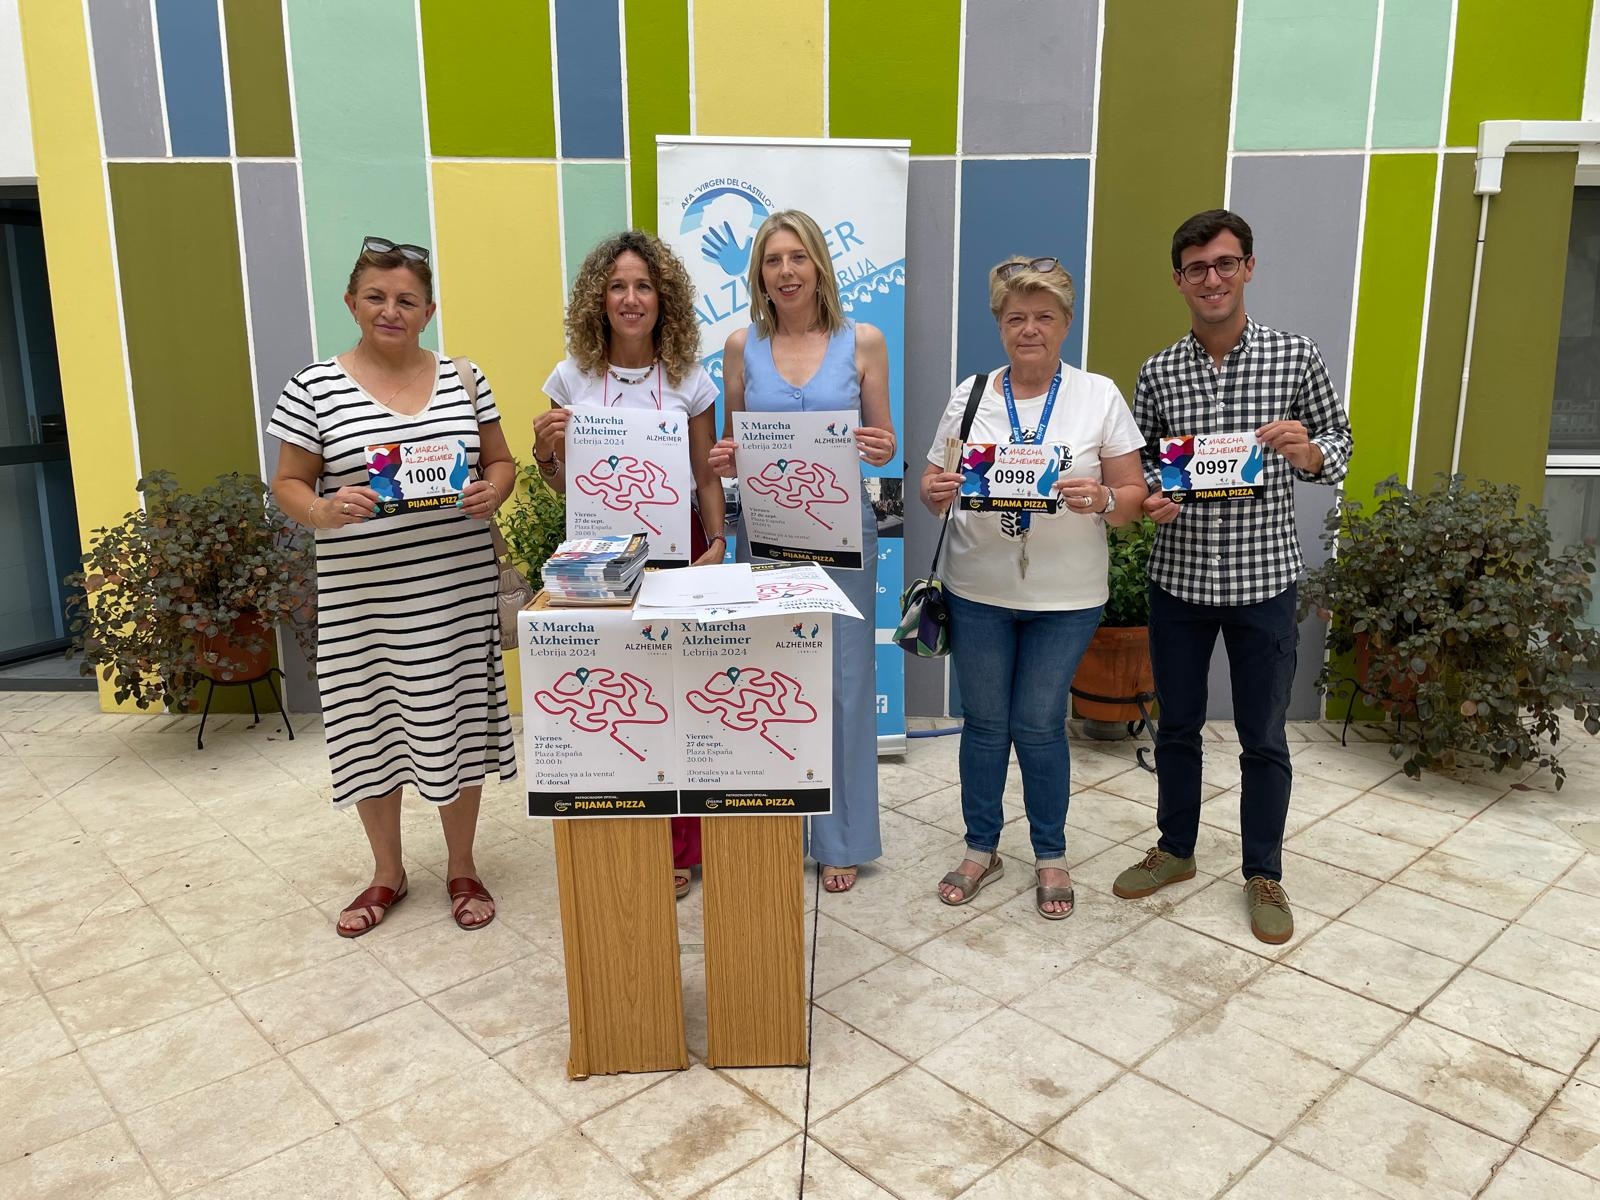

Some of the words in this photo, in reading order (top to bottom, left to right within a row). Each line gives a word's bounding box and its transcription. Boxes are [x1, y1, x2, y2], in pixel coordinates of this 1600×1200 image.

[681, 193, 695, 209] AFA
[727, 178, 740, 186] DEL
[573, 415, 582, 424] X
[584, 415, 624, 424] Marcha
[740, 421, 749, 430] X
[752, 421, 791, 430] Marcha
[573, 426, 628, 436] Alzheimer
[742, 432, 796, 440] Alzheimer
[574, 437, 602, 446] Lebrija
[742, 442, 770, 451] Lebrija
[1198, 438, 1207, 448] X
[1208, 436, 1244, 446] MARCHA
[404, 446, 414, 456] X
[415, 444, 450, 454] MARCHA
[999, 446, 1008, 456] X
[1008, 448, 1043, 456] MARCHA
[1198, 446, 1248, 456] ALZHEIMER
[405, 453, 455, 464] ALZHEIMER
[1196, 459, 1238, 475] 0997
[405, 466, 447, 484] 1000
[994, 469, 1035, 484] 0998
[1195, 490, 1228, 499] PIJAMA
[1228, 488, 1254, 496] PIZZA
[408, 498, 439, 508] PIJAMA
[440, 496, 458, 504] PIZZ
[992, 500, 1022, 508] PIJAMA
[1024, 500, 1048, 508] PIZZA
[782, 552, 810, 560] PIJAMA
[812, 554, 834, 562] PIZZA
[528, 622, 540, 632] X
[542, 622, 594, 632] Marcha
[680, 622, 691, 632] X
[695, 622, 746, 632] Marcha
[529, 634, 600, 645] Alzheimer
[682, 634, 752, 645] Alzheimer
[530, 648, 566, 657] Lebrija
[570, 648, 596, 656] 2024
[682, 648, 718, 658] Lebrija
[720, 648, 747, 656] 2024
[574, 800, 613, 810] PIJAMA
[616, 800, 646, 808] PIZZA
[725, 798, 763, 807] PIJAMA
[765, 798, 796, 806] PIZZA
